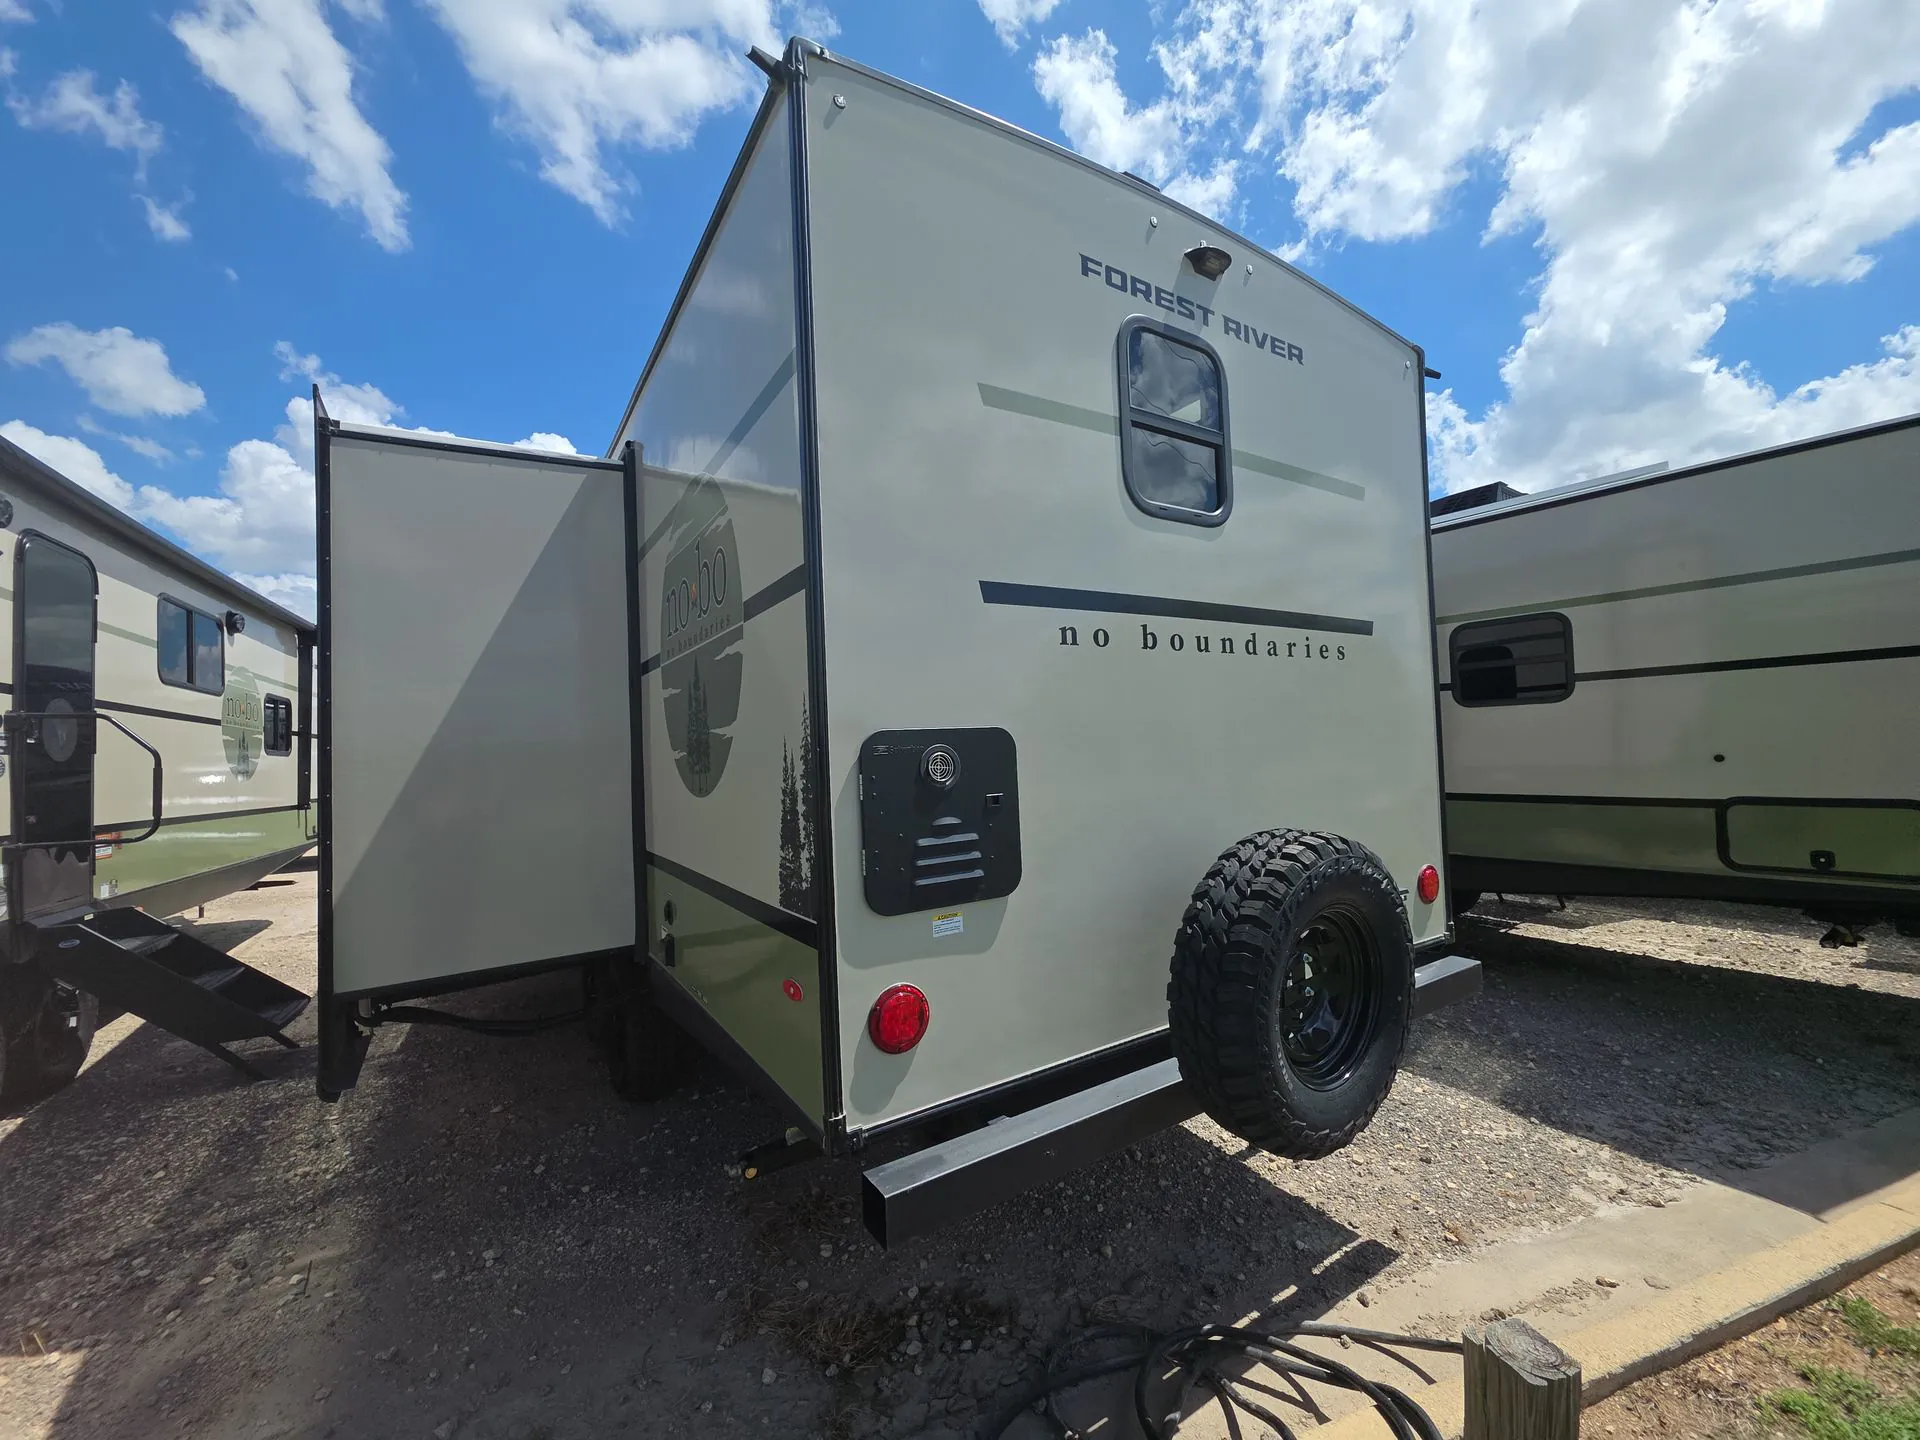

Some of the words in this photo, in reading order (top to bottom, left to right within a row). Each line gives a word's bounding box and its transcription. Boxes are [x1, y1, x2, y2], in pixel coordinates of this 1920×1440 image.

[1079, 252, 1215, 327] FOREST
[1221, 314, 1304, 365] RIVER
[678, 614, 731, 652] boundaries
[1059, 625, 1110, 649] no
[1141, 623, 1345, 661] boundaries
